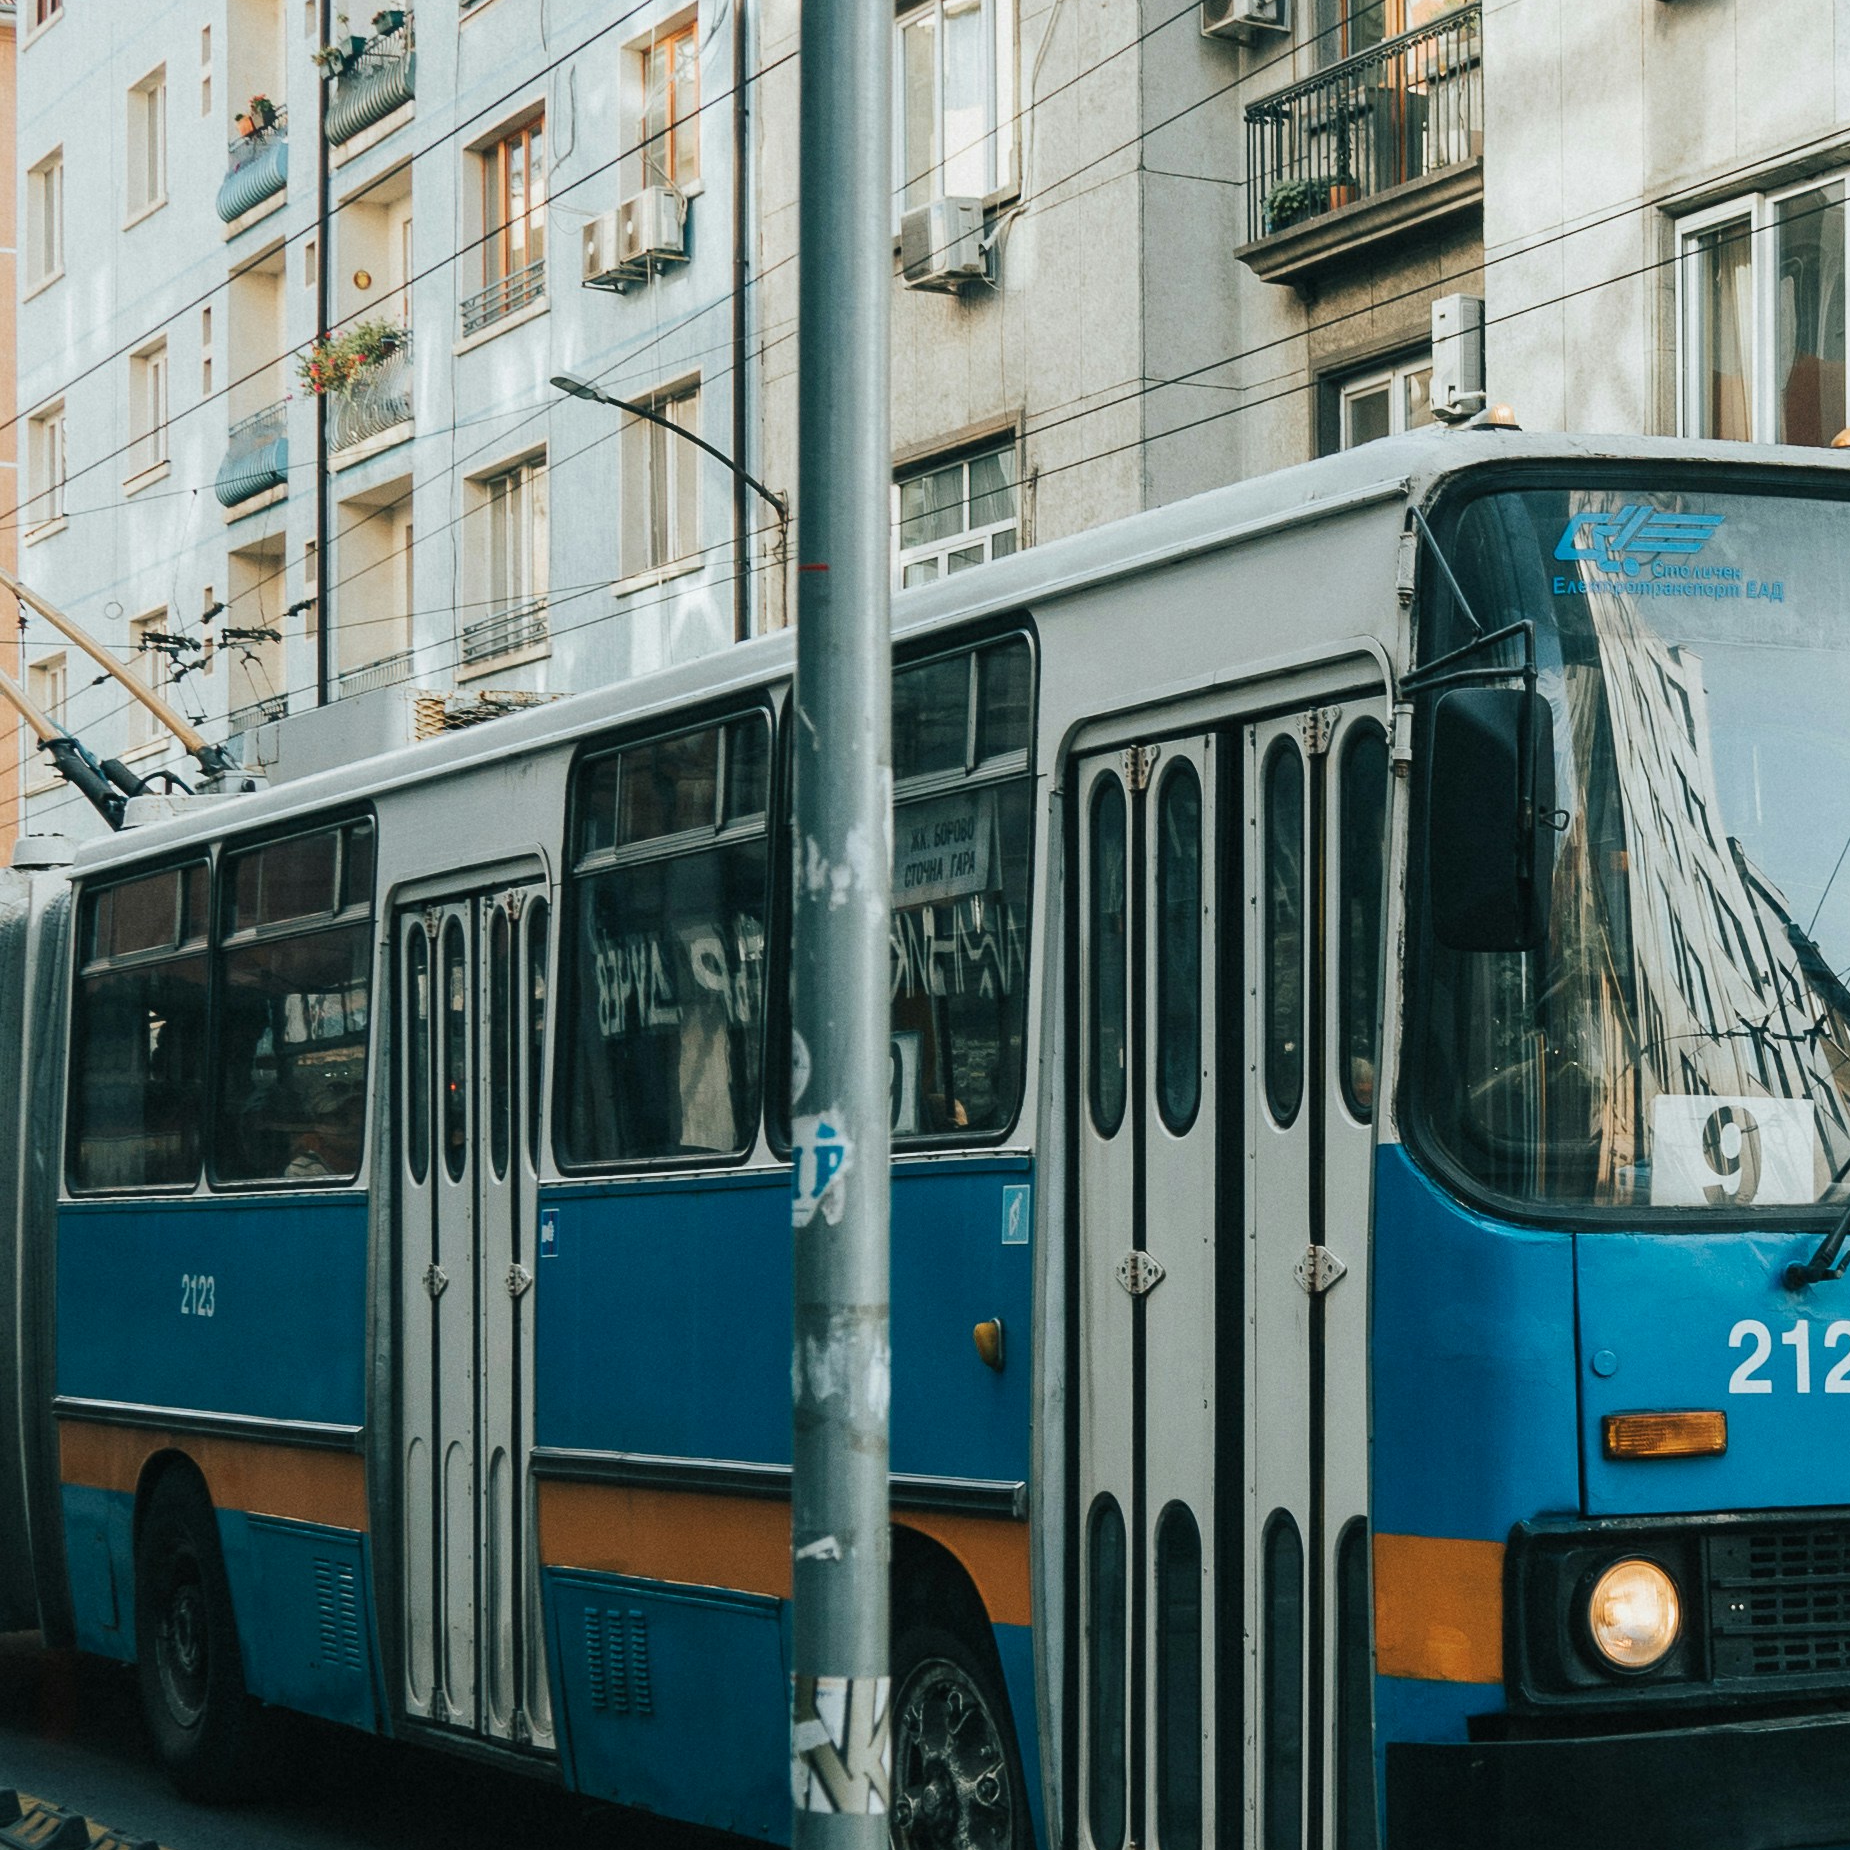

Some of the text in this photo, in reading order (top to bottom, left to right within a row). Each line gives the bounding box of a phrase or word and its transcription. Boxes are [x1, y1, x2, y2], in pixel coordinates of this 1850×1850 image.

[1651, 559, 1742, 580] Столичен
[1746, 580, 1785, 603] ЕАД
[933, 814, 976, 849] БОРОВО
[903, 849, 976, 889] СТОЧНА ГАРА
[1702, 1105, 1762, 1206] 9
[180, 1273, 215, 1318] 2123
